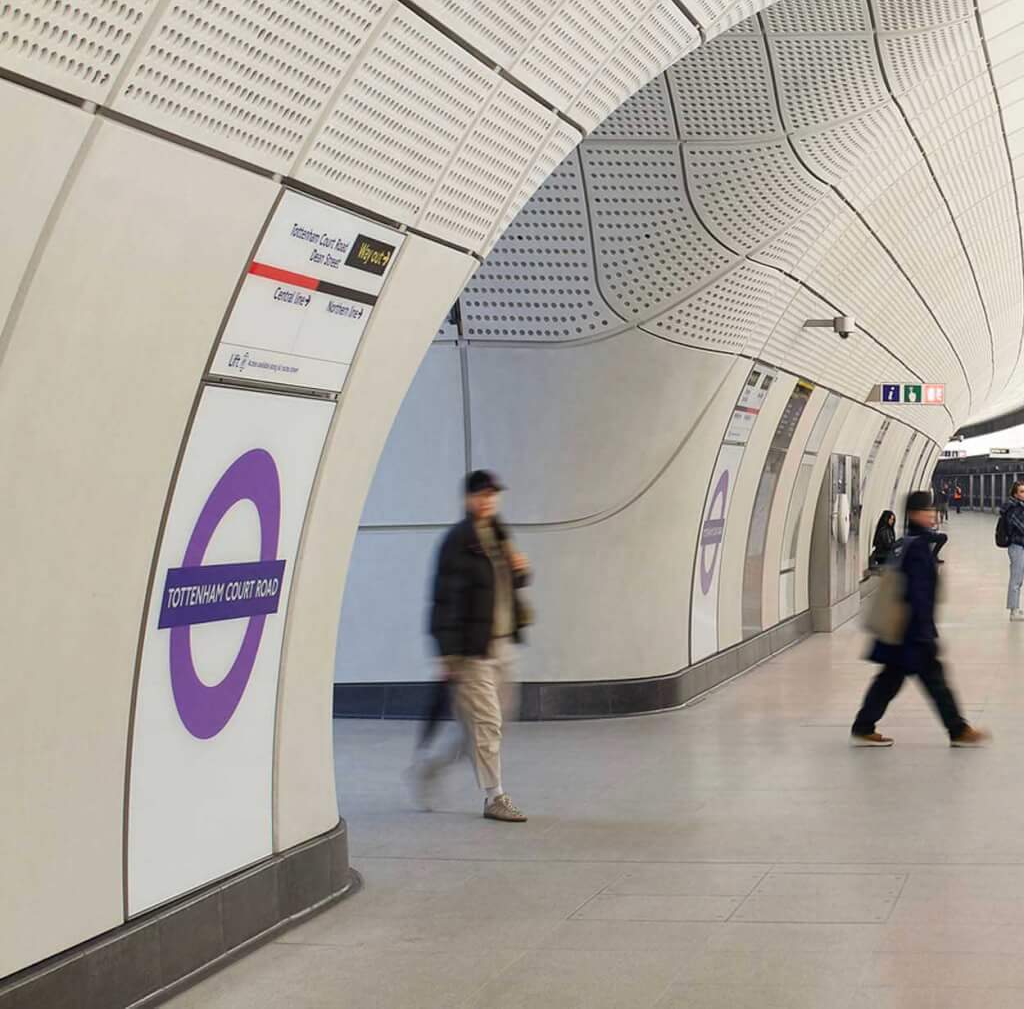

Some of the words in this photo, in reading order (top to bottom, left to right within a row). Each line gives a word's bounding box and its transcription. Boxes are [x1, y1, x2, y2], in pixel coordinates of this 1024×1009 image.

[358, 241, 371, 264] Way
[273, 287, 294, 303] Central
[294, 293, 306, 305] line
[167, 583, 225, 608] TOTTENHAM
[225, 580, 255, 601] COURT
[255, 578, 279, 597] ROAD
